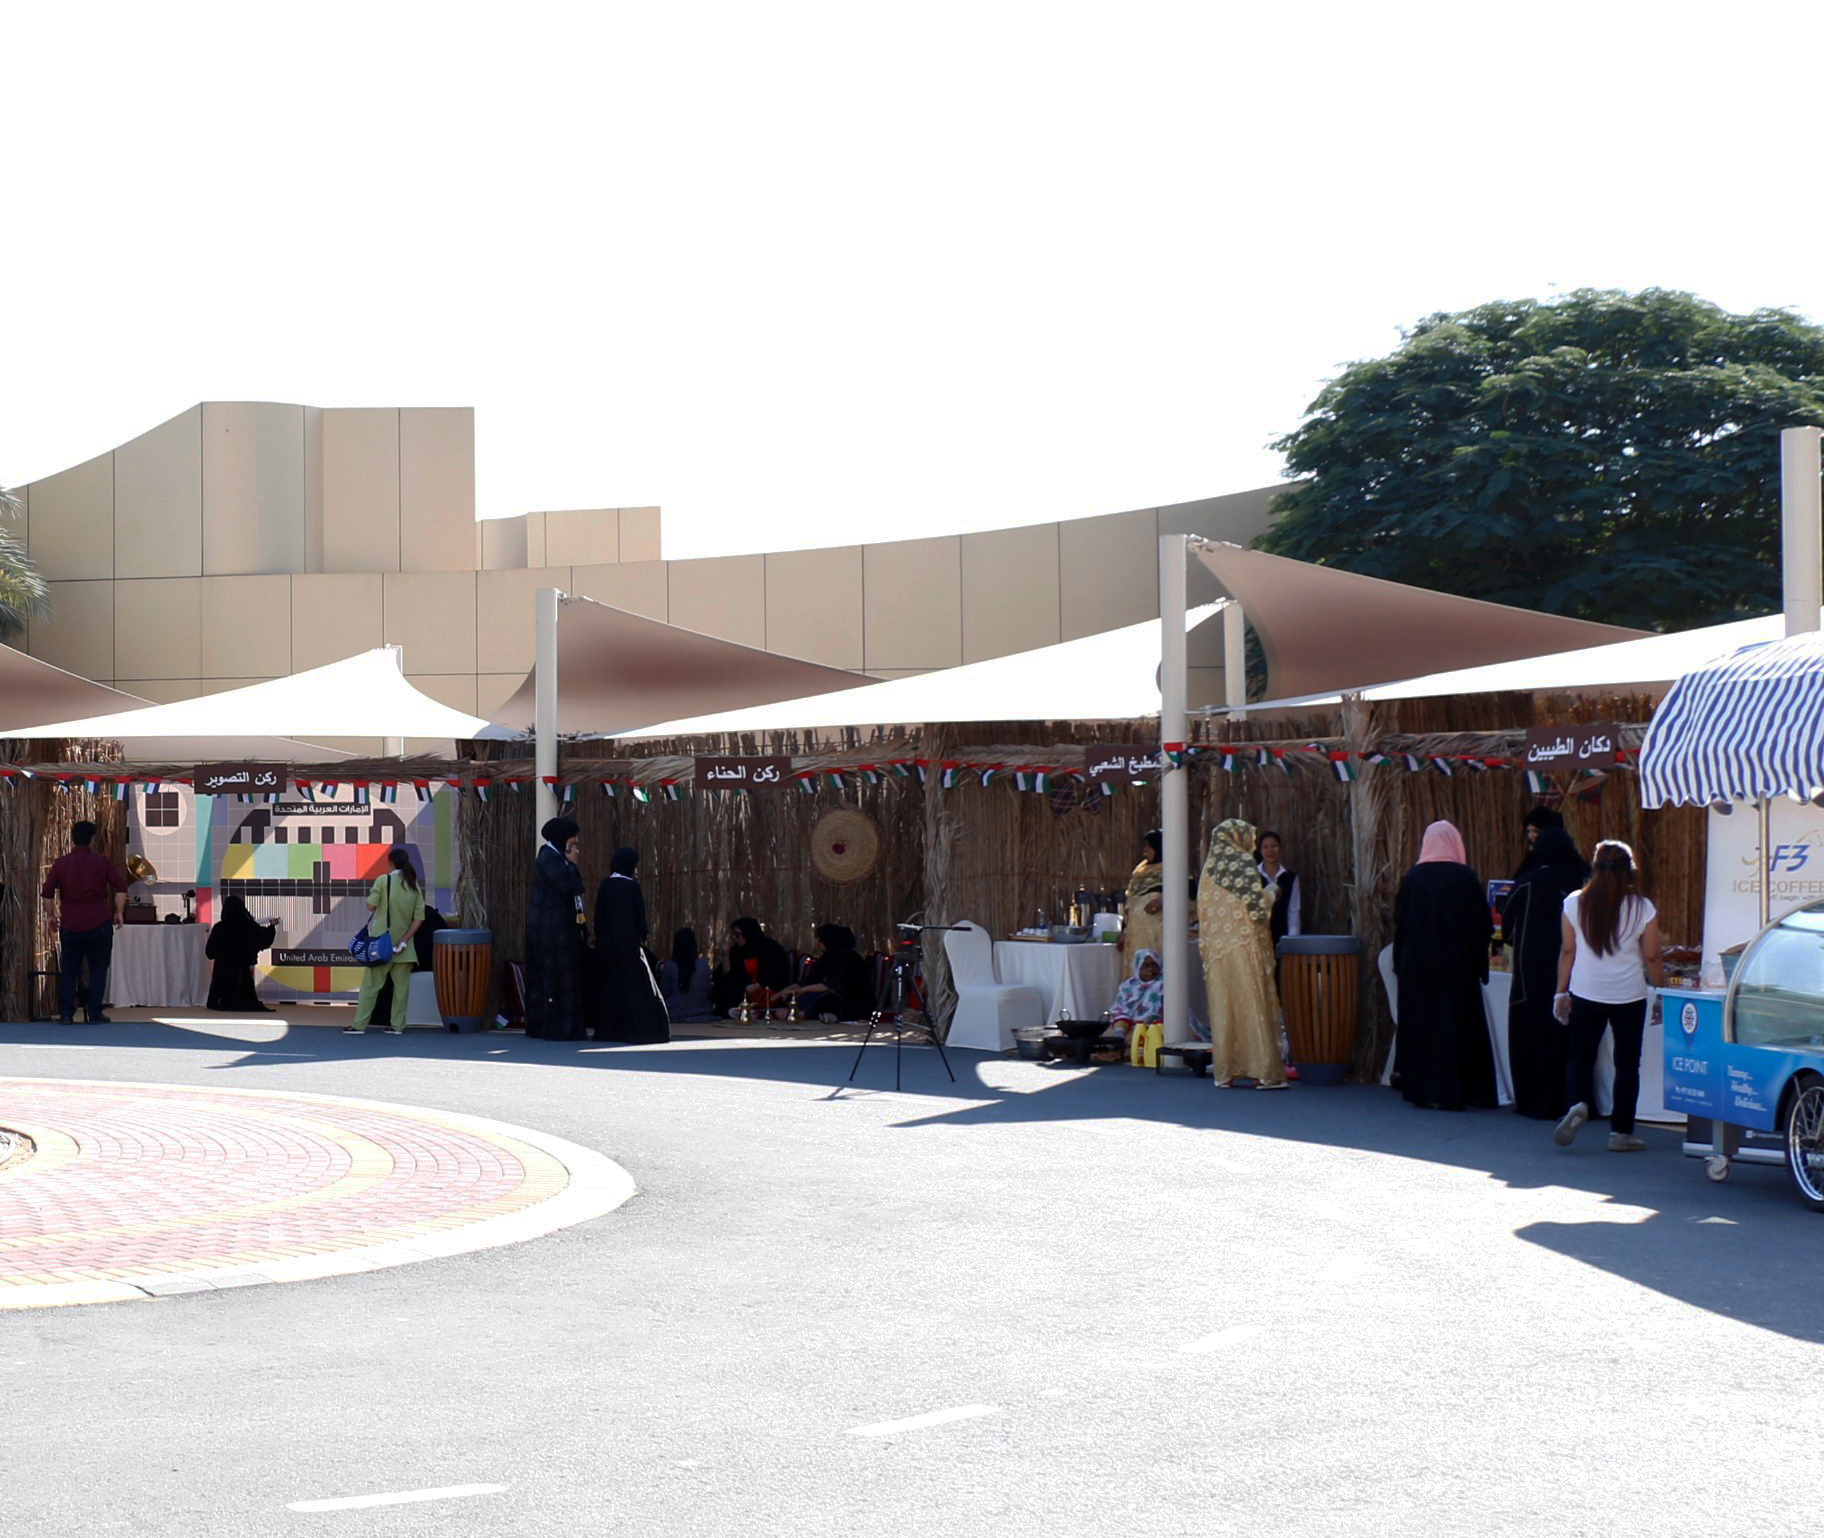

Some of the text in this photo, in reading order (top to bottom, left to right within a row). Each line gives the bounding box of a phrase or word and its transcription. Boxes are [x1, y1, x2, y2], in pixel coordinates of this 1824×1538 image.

[1528, 735, 1611, 762] دكان الطيبين
[707, 765, 780, 782] ركن الحناء
[1089, 755, 1163, 777] لمطبخ الشعبي
[204, 771, 277, 788] ركن التصوير
[274, 803, 369, 815] الإمارات العربية المتحدة
[1732, 880, 1761, 893] ICE
[279, 953, 357, 962] United Arab Emira
[1672, 1056, 1708, 1075] ICE POINT
